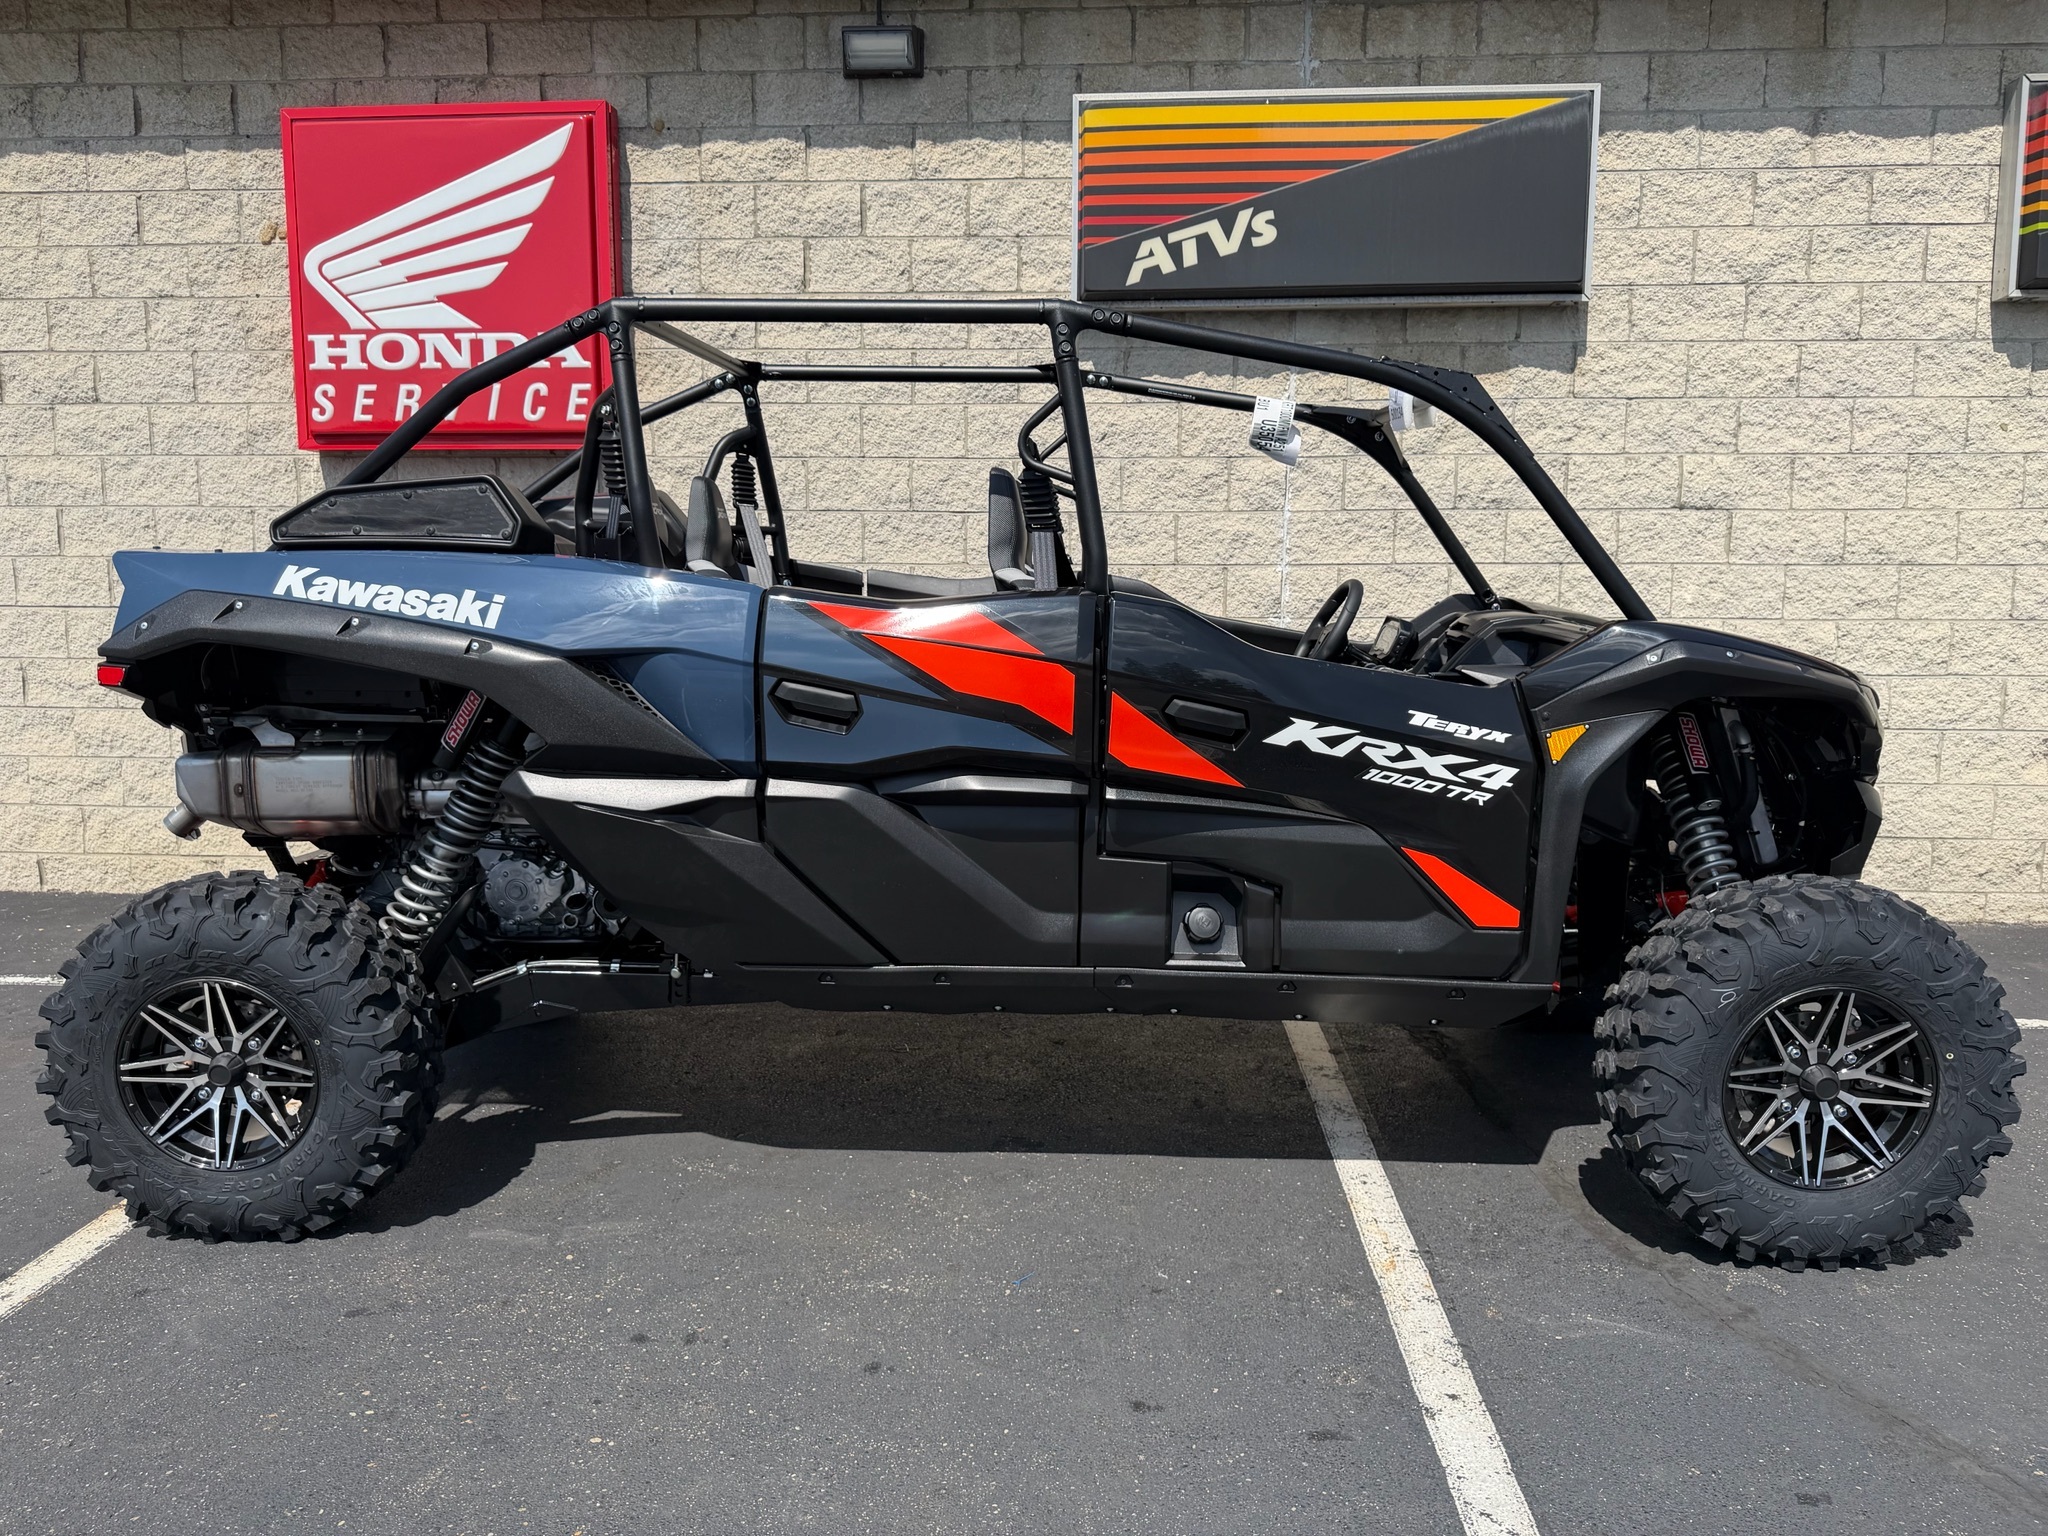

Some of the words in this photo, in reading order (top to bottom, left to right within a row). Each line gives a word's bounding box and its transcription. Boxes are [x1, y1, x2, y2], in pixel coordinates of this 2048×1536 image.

[307, 332, 592, 371] HONDA
[311, 383, 592, 422] SERICE
[273, 565, 505, 629] Kawasaki
[446, 690, 481, 748] SHOWA
[1679, 716, 1709, 769] SHOWA
[1262, 717, 1520, 790] KRX4
[1362, 768, 1442, 793] 1000
[1446, 784, 1494, 806] TR
[221, 1131, 325, 1193] CARNIVORE
[1703, 1116, 1797, 1207] CARNIVORE
